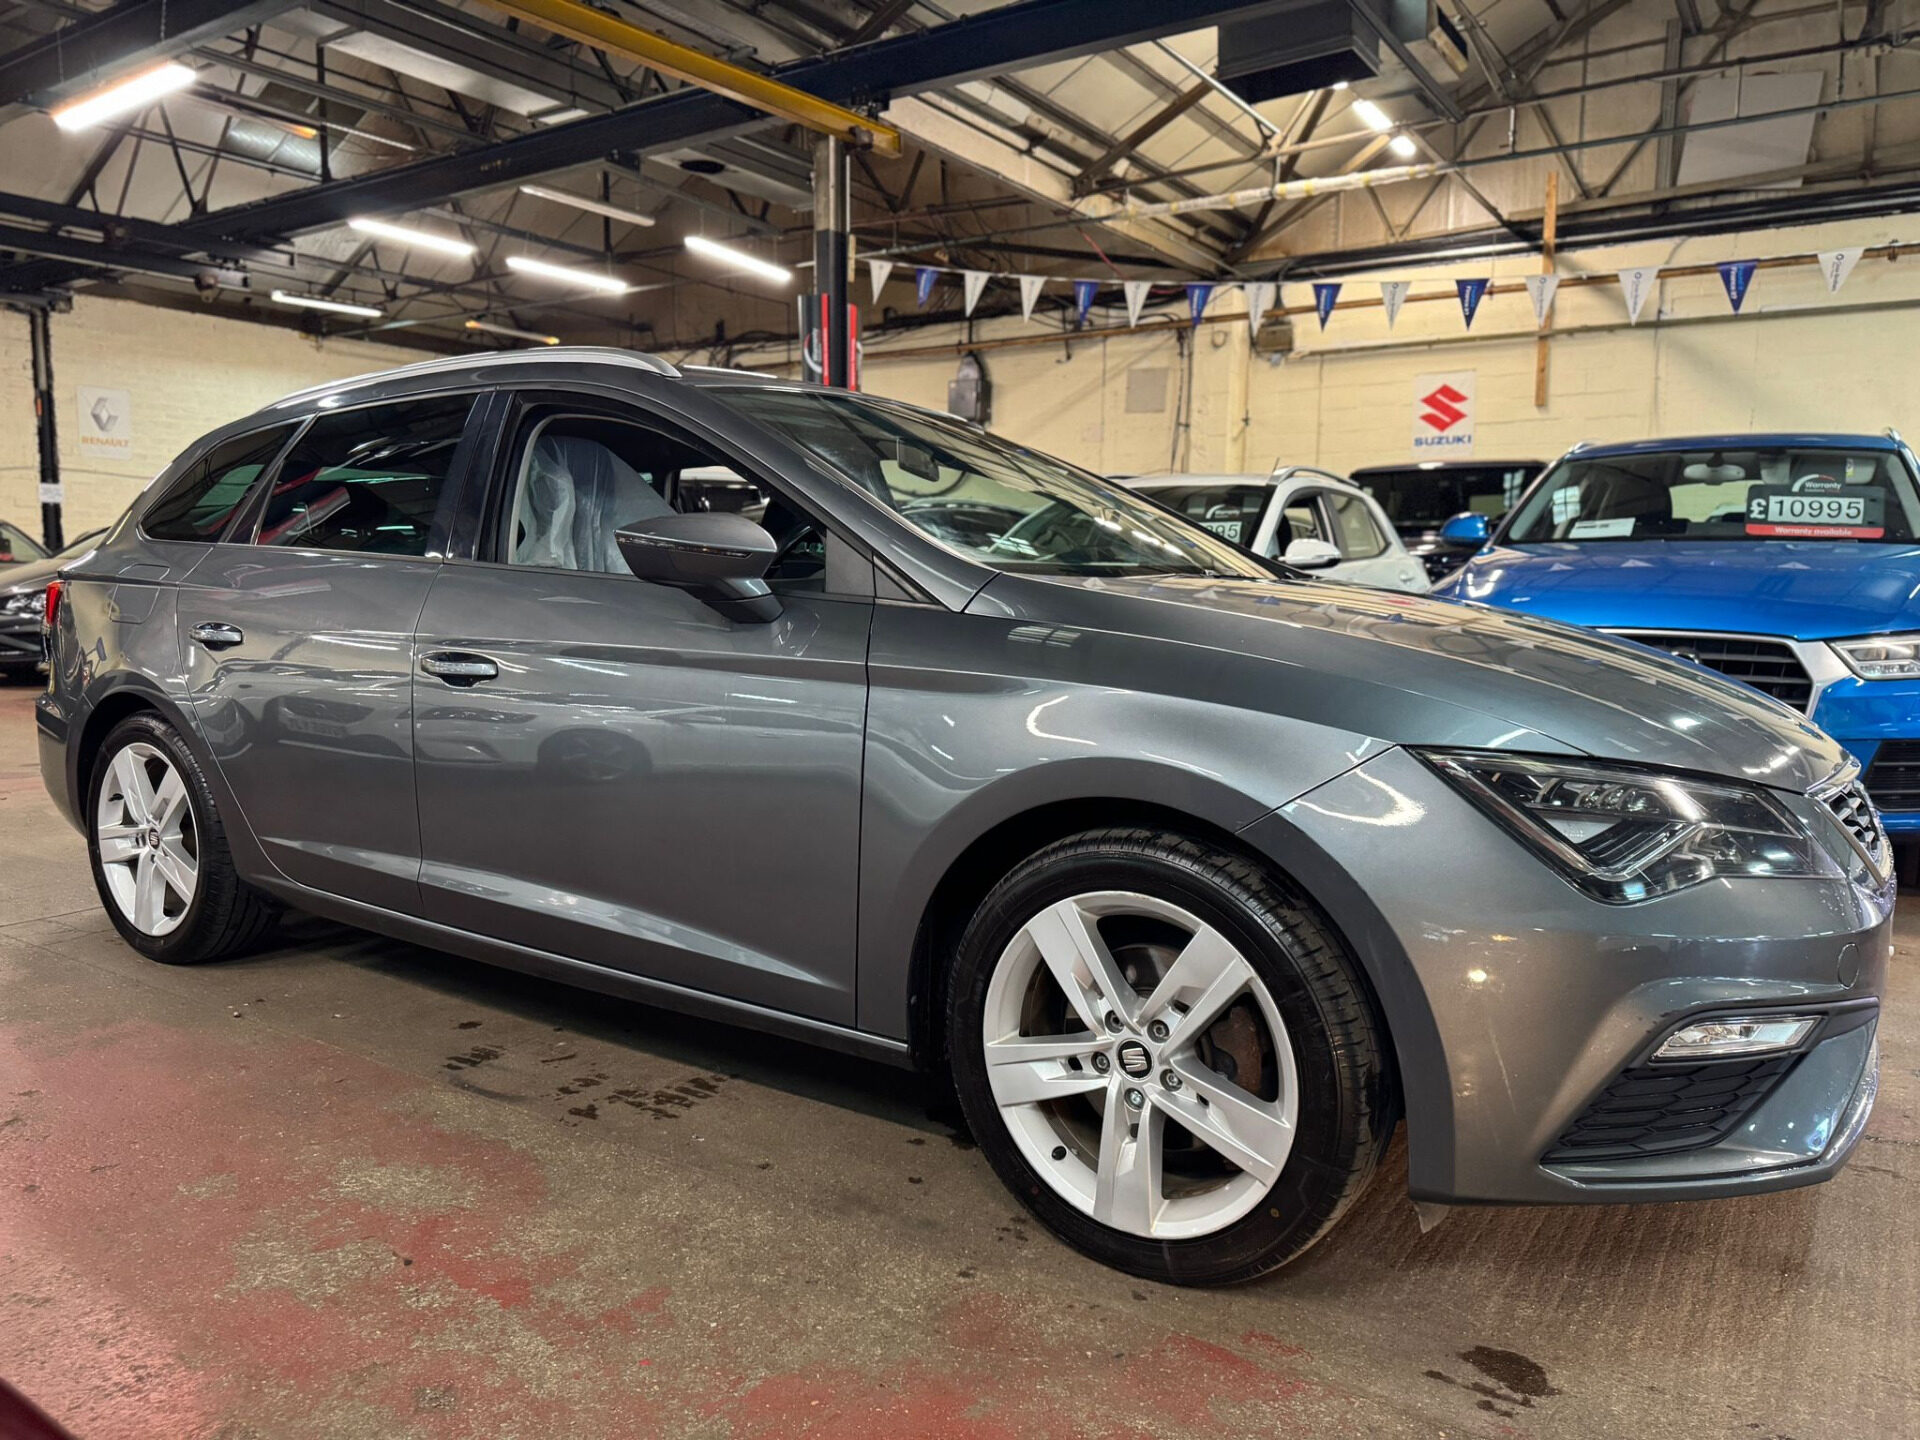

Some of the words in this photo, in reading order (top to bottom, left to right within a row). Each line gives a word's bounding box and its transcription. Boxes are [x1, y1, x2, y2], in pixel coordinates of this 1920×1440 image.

[81, 436, 129, 447] RENAULT
[1414, 435, 1472, 446] SUZUKI
[1804, 481, 1842, 490] Warranty
[1774, 525, 1812, 536] Warranty
[1814, 527, 1853, 536] available
